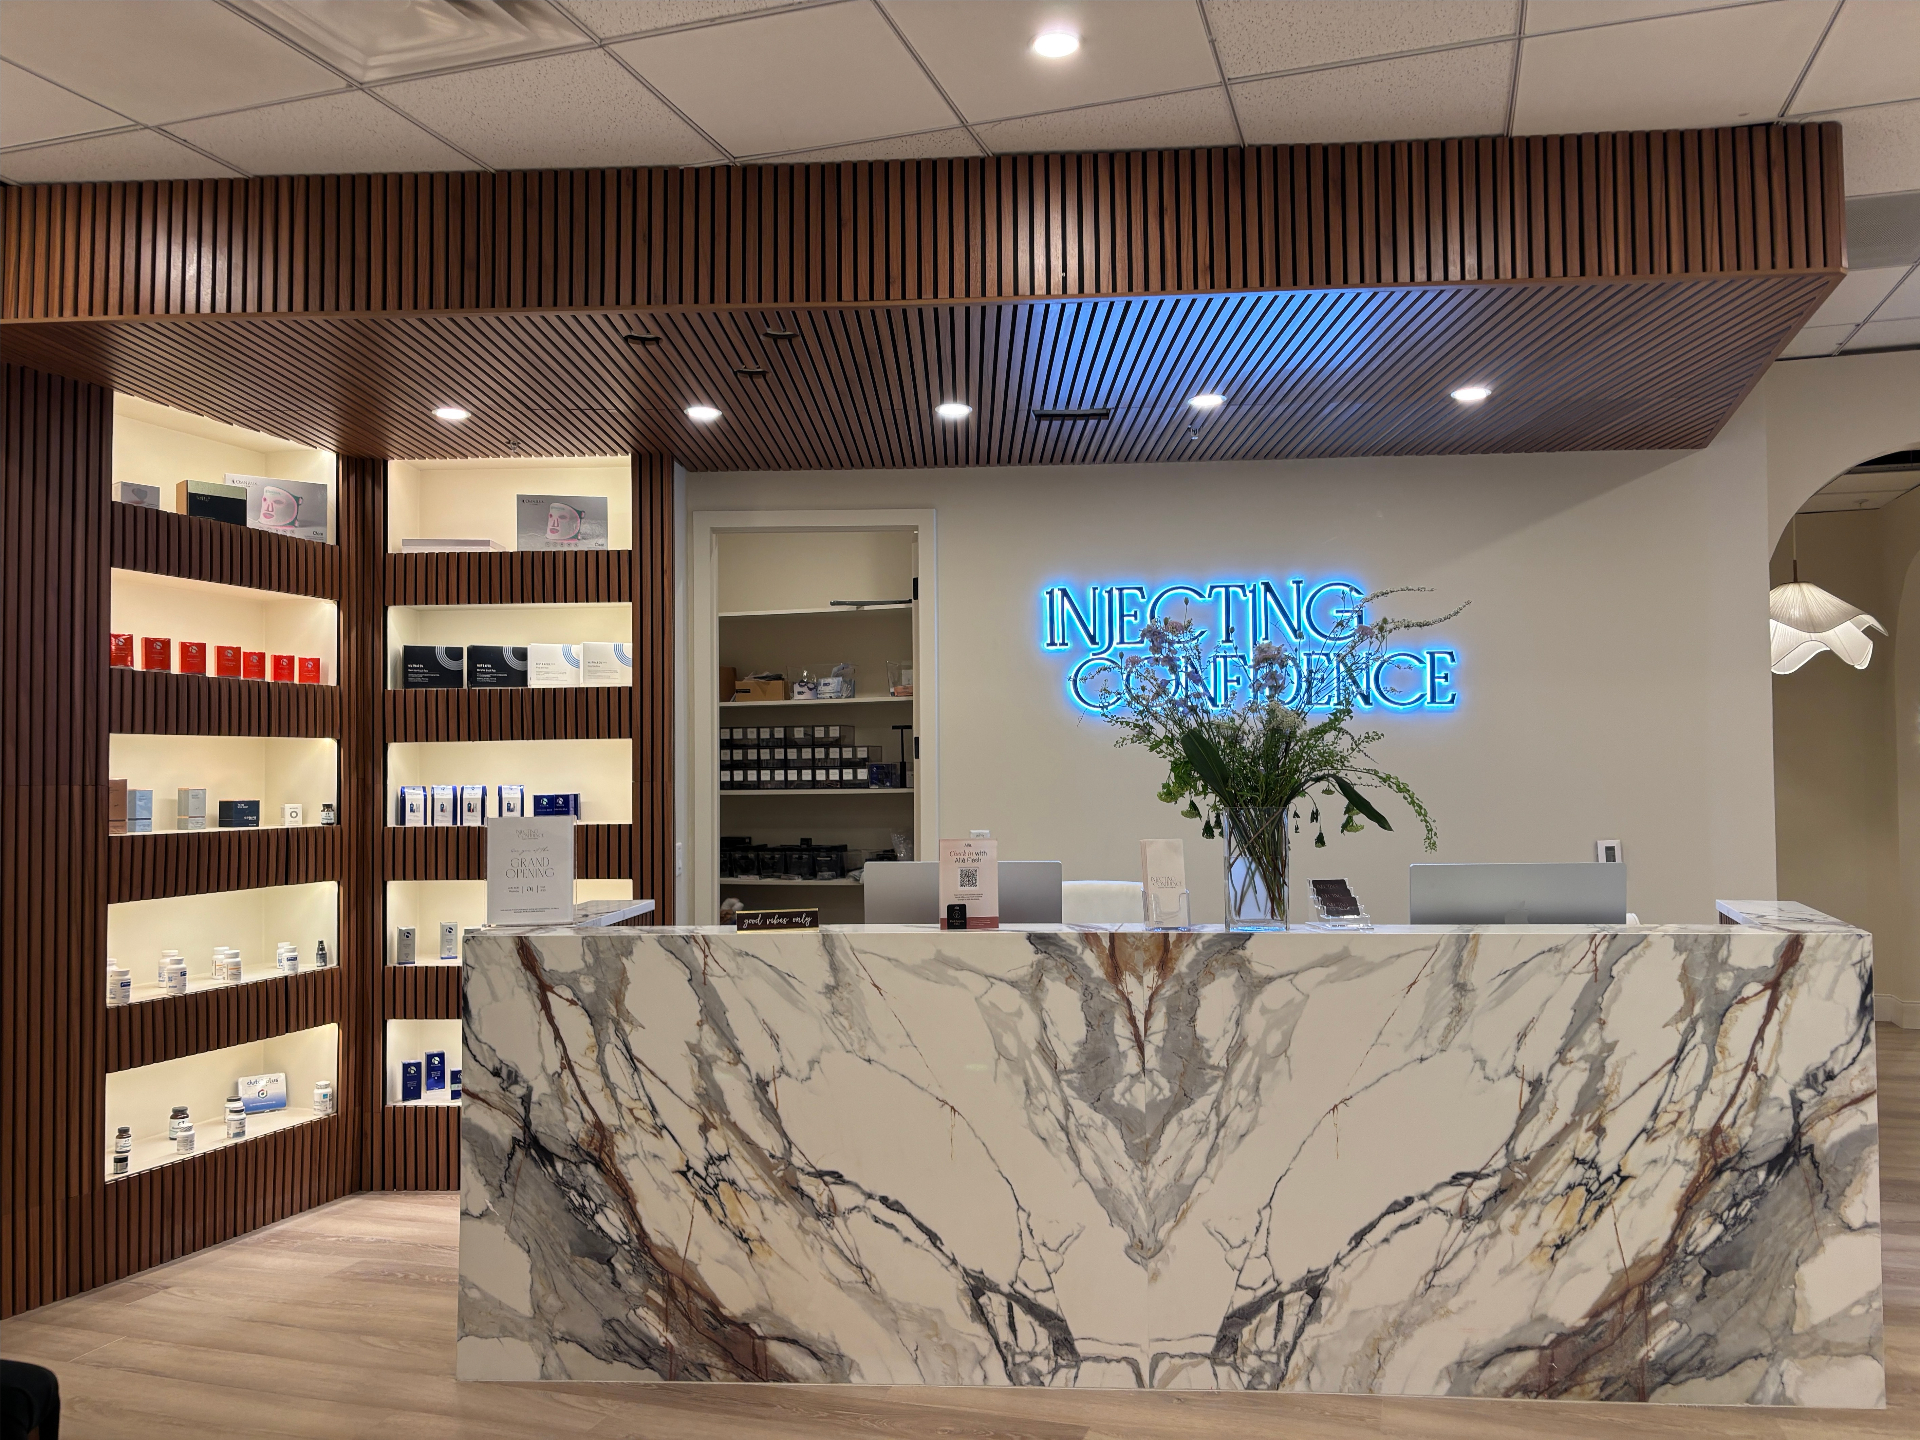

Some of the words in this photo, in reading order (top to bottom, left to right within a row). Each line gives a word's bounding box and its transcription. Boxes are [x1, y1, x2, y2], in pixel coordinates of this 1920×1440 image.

[1045, 579, 1364, 657] INJECTING
[974, 849, 988, 857] with
[510, 857, 549, 868] GRAND
[505, 867, 555, 879] OPENING
[743, 913, 763, 928] good
[766, 914, 789, 925] vibes
[792, 912, 812, 926] only
